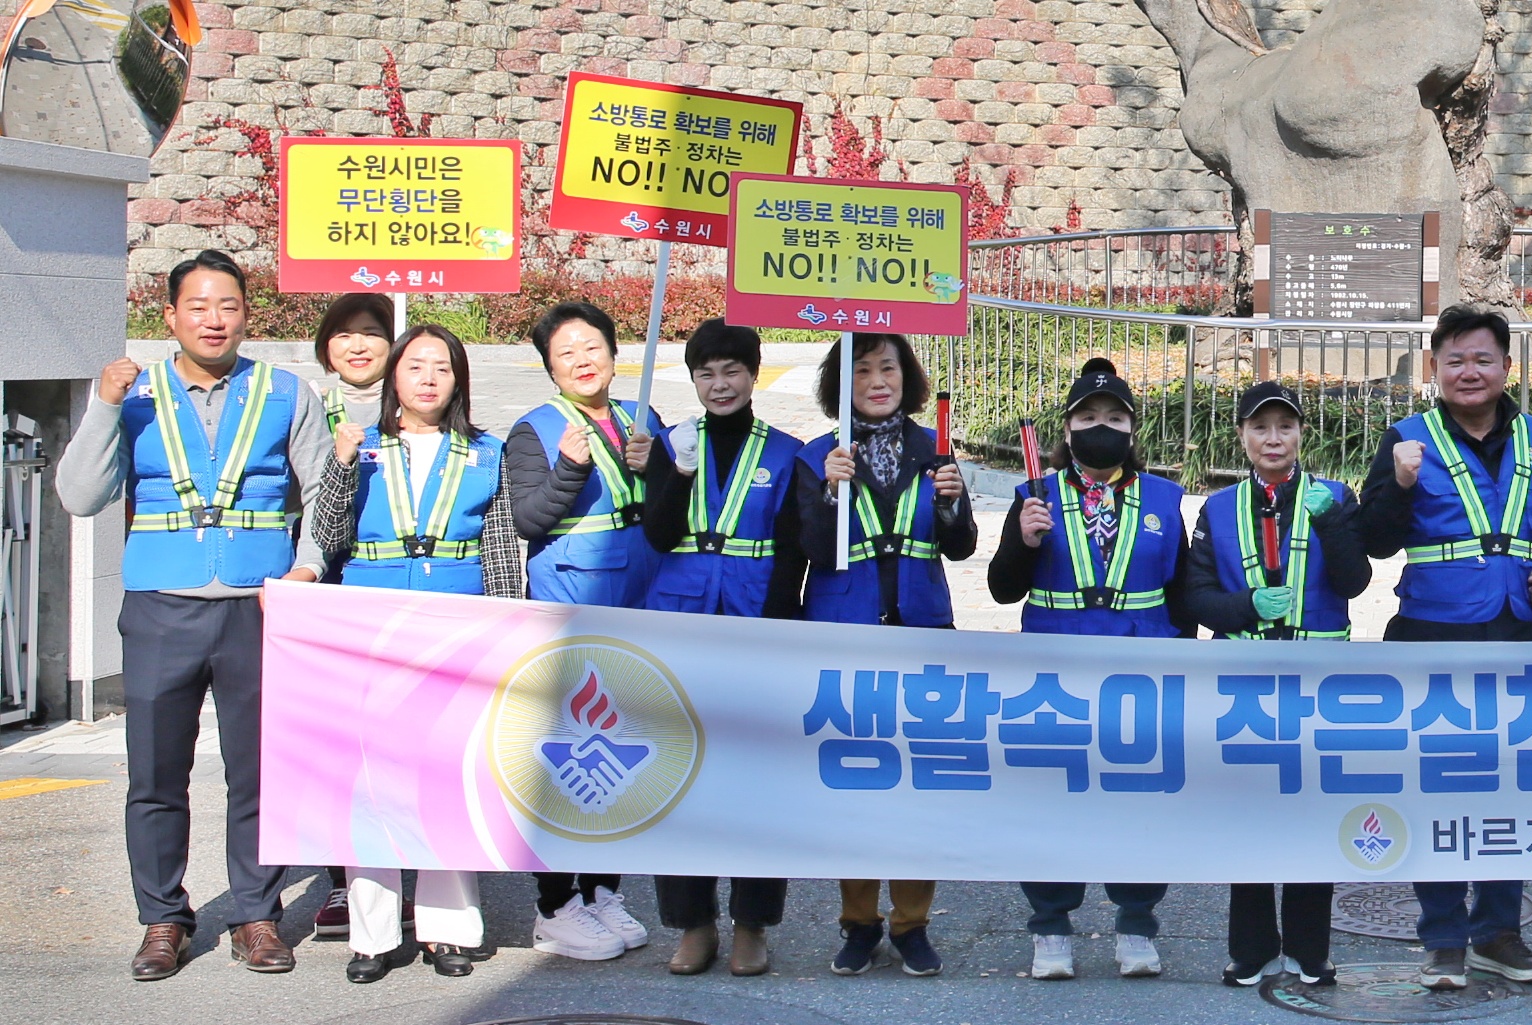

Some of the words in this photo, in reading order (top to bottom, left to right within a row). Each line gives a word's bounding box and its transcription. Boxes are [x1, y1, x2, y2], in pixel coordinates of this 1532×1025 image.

[588, 101, 668, 130] 소방통로
[673, 111, 732, 140] 확보를
[738, 120, 777, 146] 위해
[337, 155, 463, 180] 수원시민은
[591, 156, 667, 192] NO!!
[336, 188, 463, 214] 무단횡단을
[753, 198, 834, 223] 소방통로
[840, 203, 899, 227] 확보를
[906, 207, 944, 230] 위해
[327, 221, 376, 246] 하지
[388, 221, 471, 246] 않아요!
[762, 251, 838, 283] NO!!
[856, 257, 930, 288] NO!!
[802, 664, 1187, 795] 생활속의
